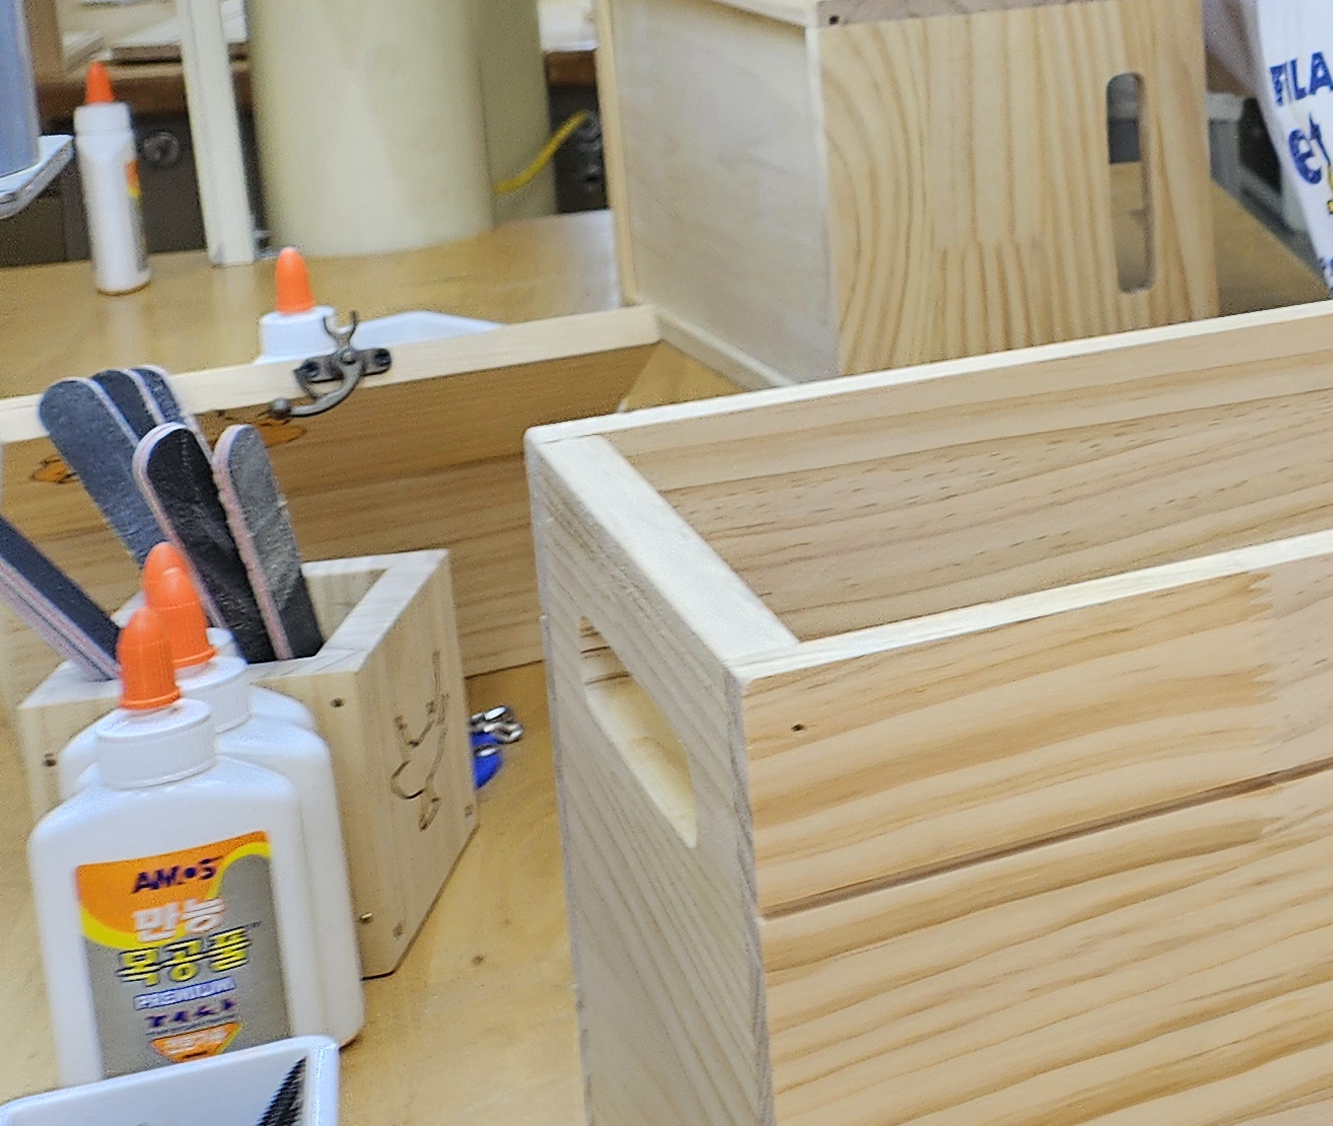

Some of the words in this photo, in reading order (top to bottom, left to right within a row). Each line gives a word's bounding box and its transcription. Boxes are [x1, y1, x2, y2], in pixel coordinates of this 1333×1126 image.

[1288, 112, 1331, 185] et
[131, 855, 222, 895] AMOS
[132, 896, 226, 944] 만능
[115, 924, 252, 988] 목공풀
